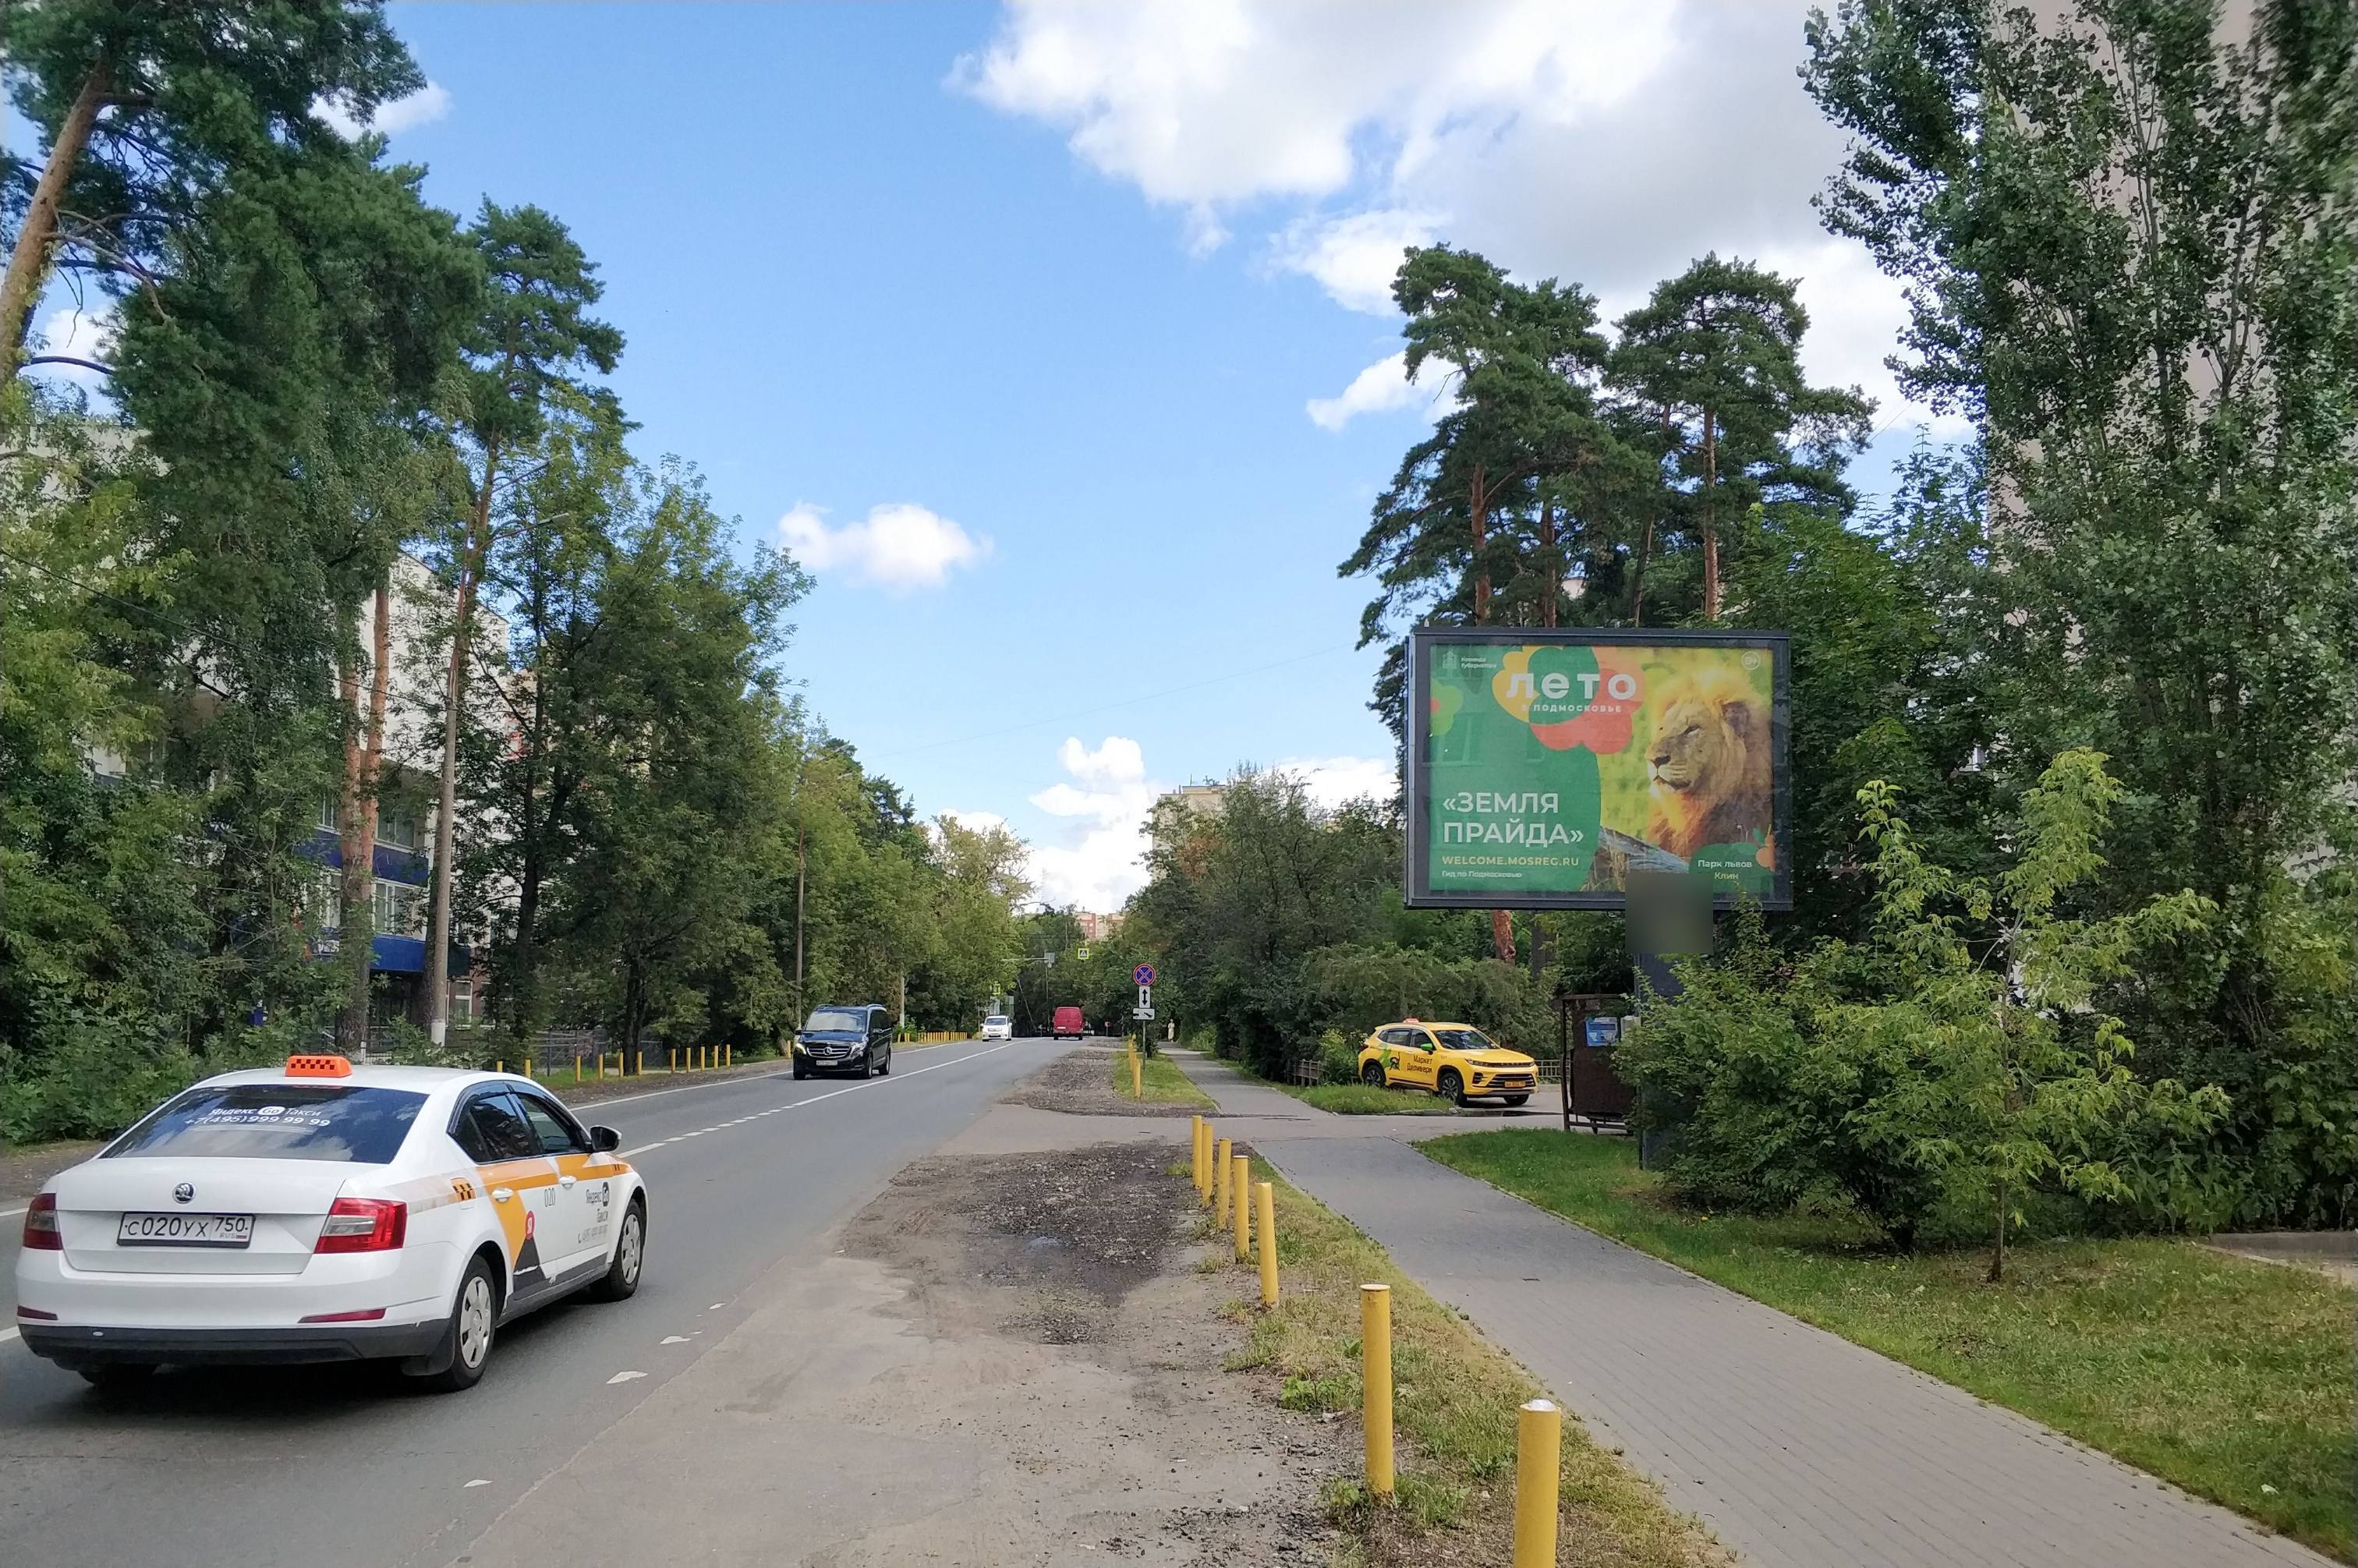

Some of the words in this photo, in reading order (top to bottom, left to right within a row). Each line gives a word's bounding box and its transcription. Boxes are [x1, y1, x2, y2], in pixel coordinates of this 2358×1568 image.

[1443, 791, 1559, 813] «ЗЕМЛЯ
[1443, 818, 1584, 848] ПРАЙДА»
[1443, 856, 1579, 866] WELCOME.MOSREG.RU
[1698, 860, 1722, 869] Парк
[286, 1107, 321, 1117] Такси
[282, 1116, 304, 1124] 99
[308, 1118, 331, 1127] 99
[214, 1216, 246, 1232] 750
